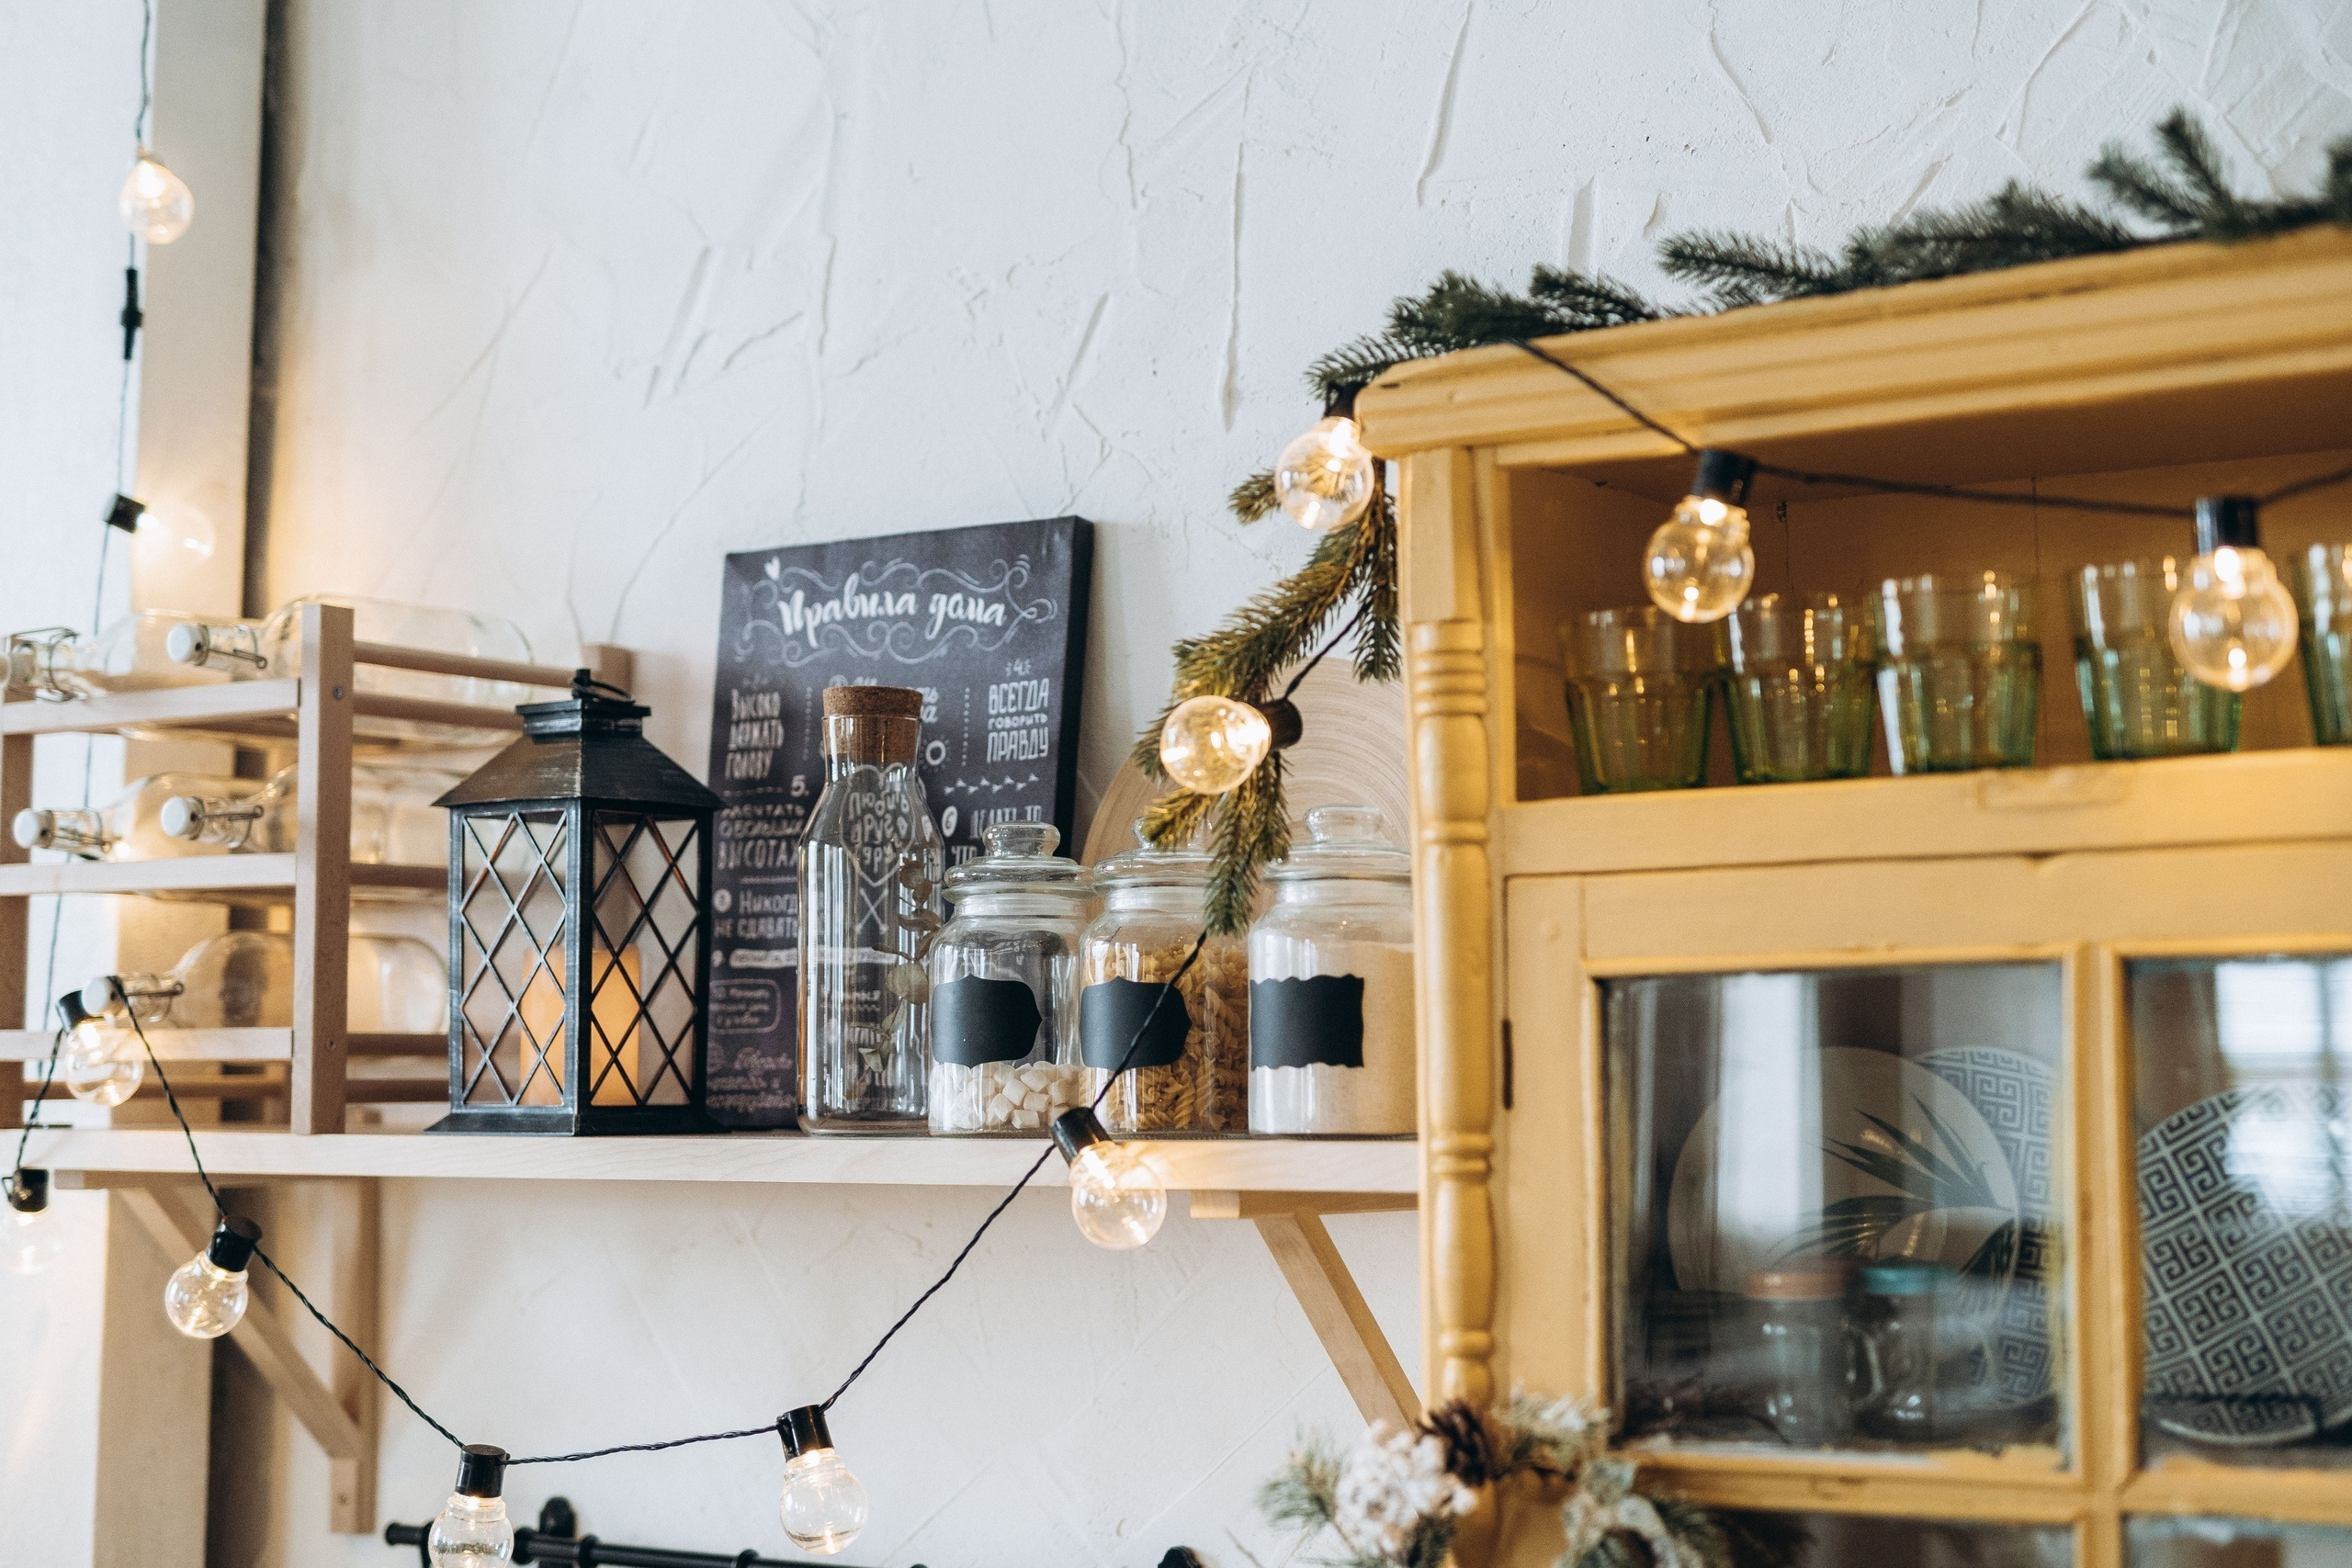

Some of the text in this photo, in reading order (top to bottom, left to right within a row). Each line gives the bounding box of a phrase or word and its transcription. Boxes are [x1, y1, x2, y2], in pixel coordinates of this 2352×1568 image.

[777, 571, 916, 649] Правила
[988, 677, 1049, 715] ВСЕГДА
[986, 726, 1048, 763] ПРАВДУ
